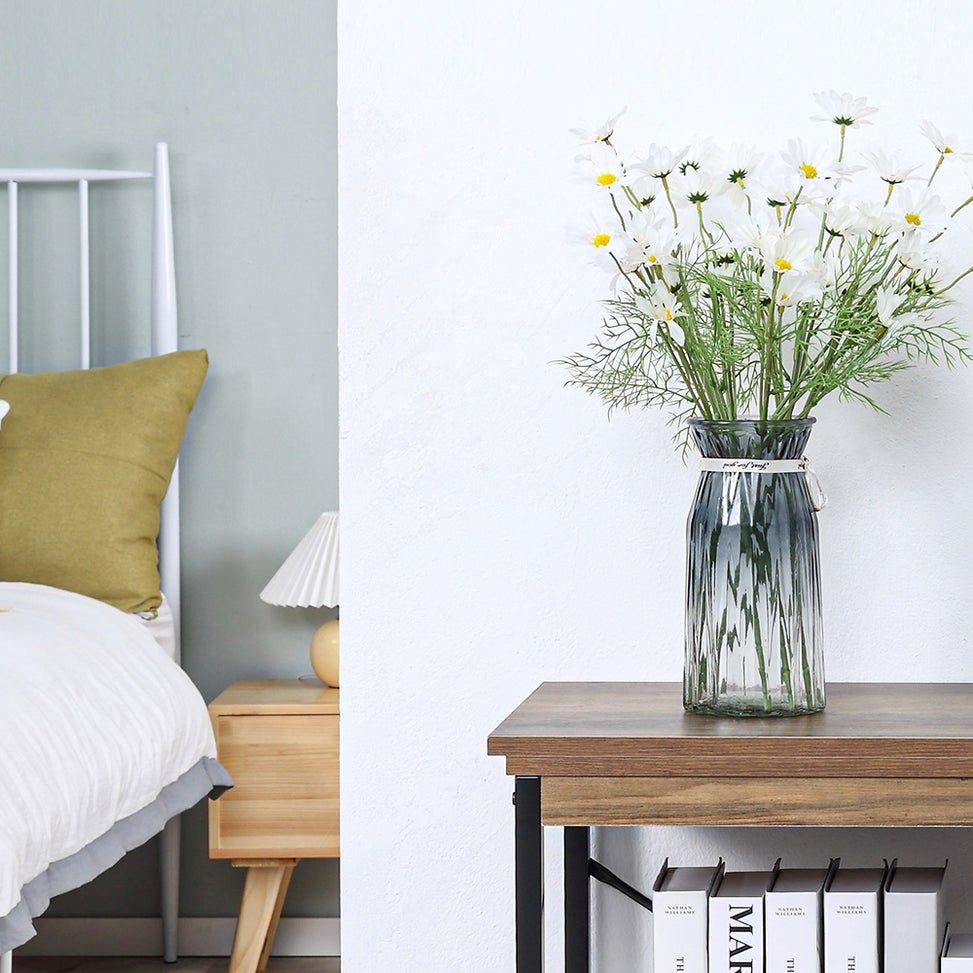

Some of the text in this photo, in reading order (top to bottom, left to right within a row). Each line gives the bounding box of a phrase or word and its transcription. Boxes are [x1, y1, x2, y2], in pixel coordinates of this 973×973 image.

[722, 461, 770, 470] Just for you
